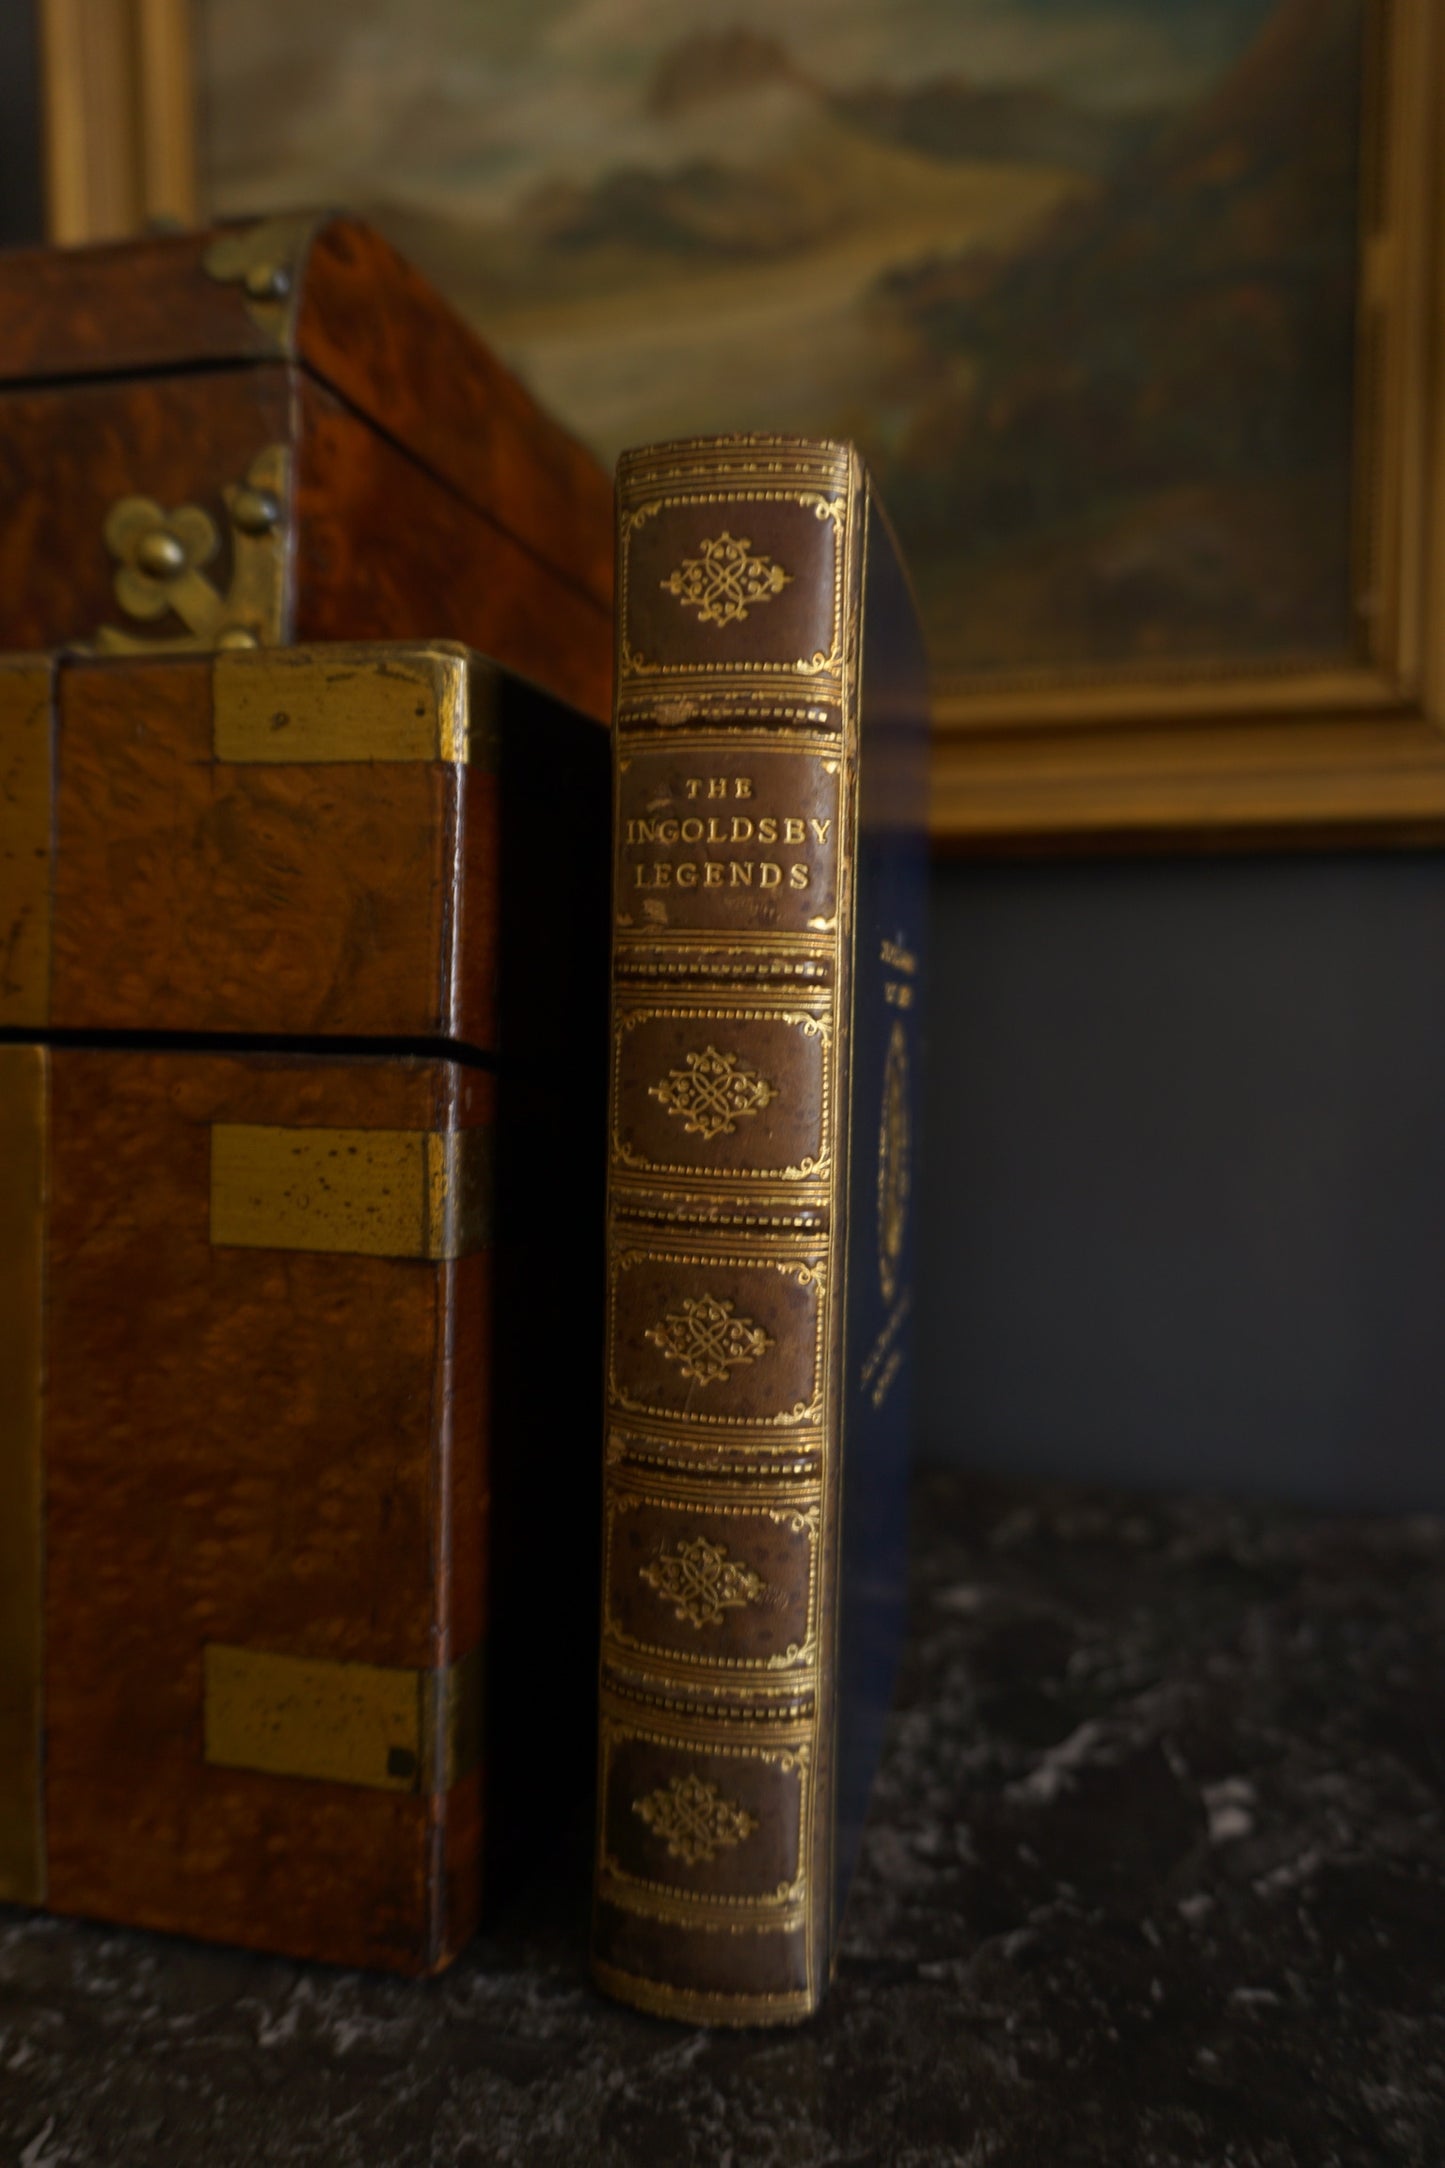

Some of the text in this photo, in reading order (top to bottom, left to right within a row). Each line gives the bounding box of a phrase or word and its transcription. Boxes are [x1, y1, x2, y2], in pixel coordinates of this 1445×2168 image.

[686, 778, 752, 799] THE
[627, 817, 831, 845] INGOLDSBY
[635, 862, 809, 889] LEGENDS
